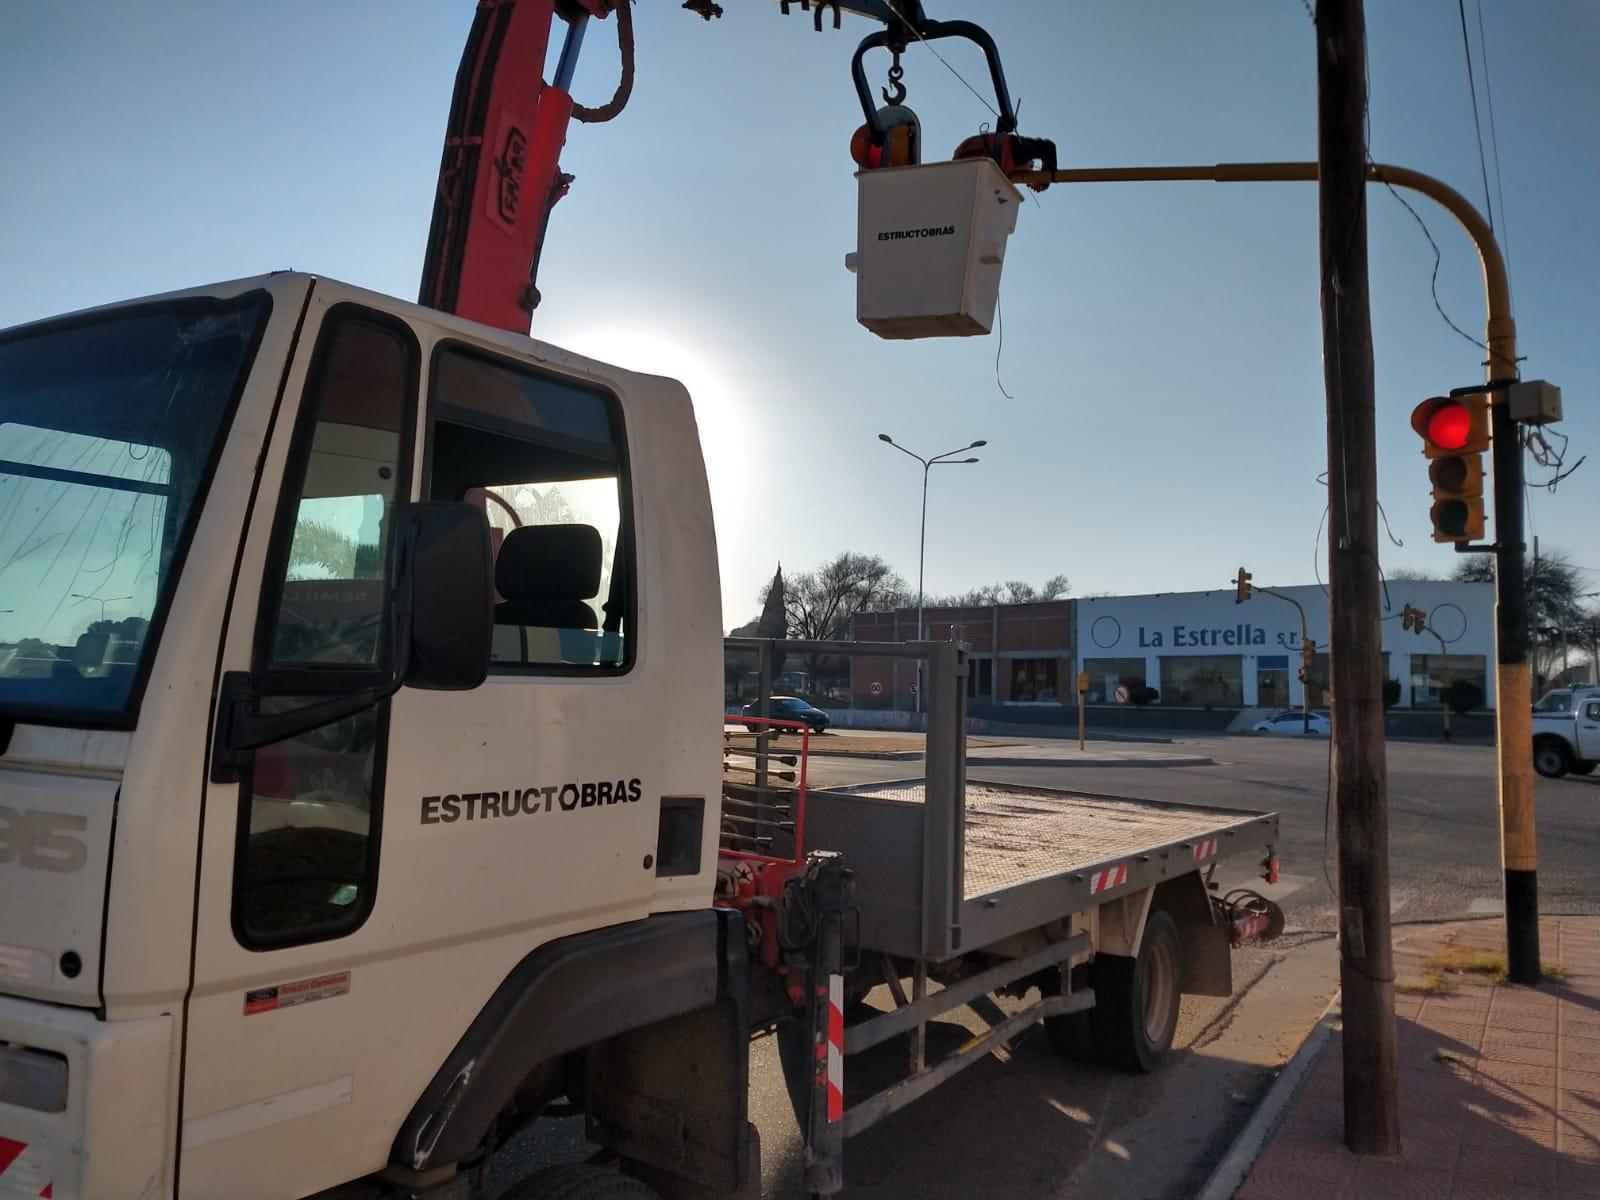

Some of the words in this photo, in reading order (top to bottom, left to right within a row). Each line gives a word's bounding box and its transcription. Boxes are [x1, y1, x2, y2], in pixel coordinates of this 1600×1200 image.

[877, 226, 955, 241] ESTRUCTOBRAS
[1139, 627, 1163, 648] La
[1173, 624, 1266, 647] Estrella
[420, 778, 642, 825] ESTRUCTOBRAS
